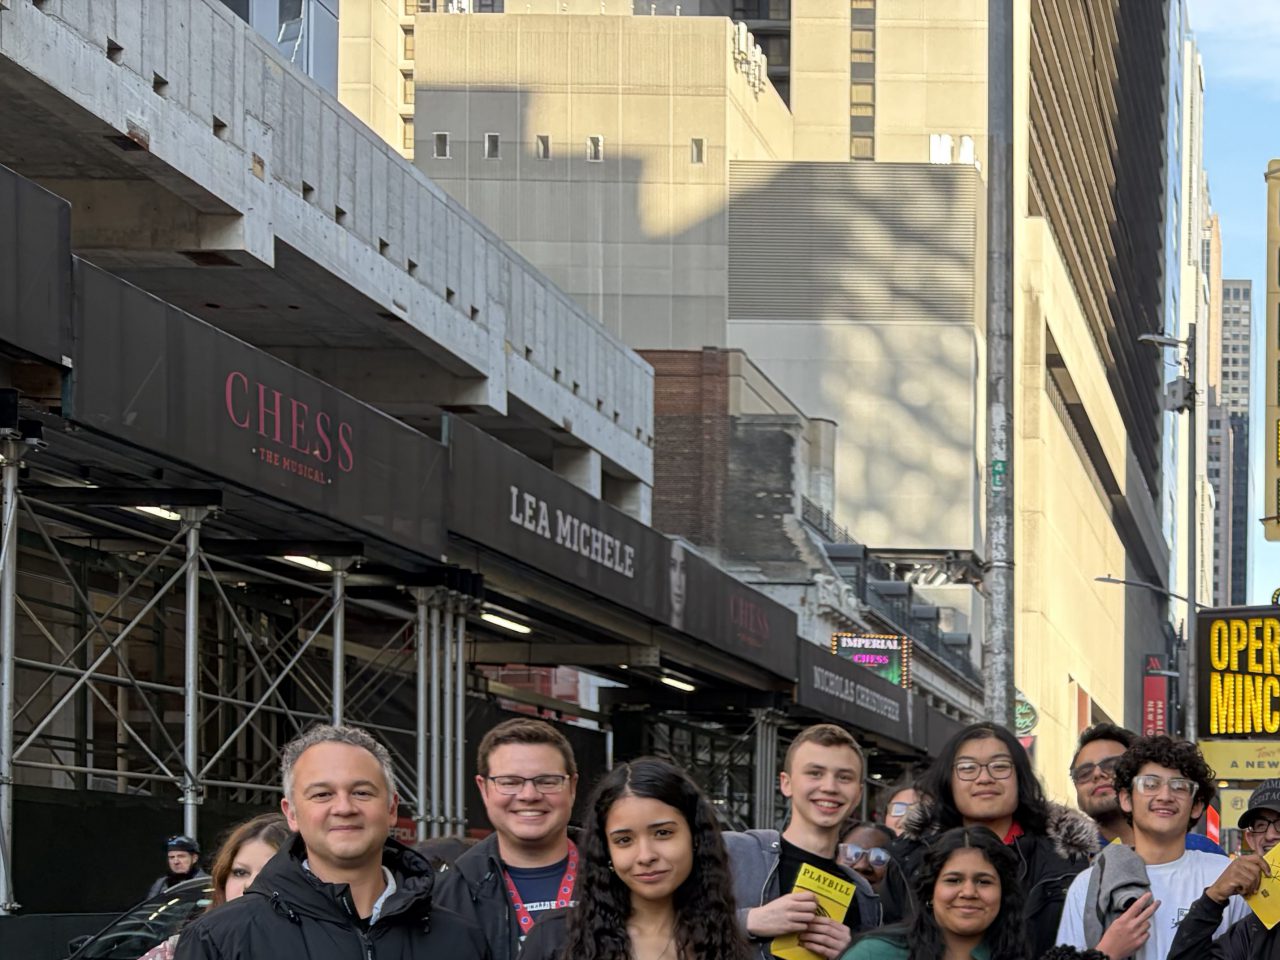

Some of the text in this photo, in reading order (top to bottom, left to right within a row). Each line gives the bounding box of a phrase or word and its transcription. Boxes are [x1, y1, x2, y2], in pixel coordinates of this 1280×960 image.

[225, 370, 353, 472] CHESS
[259, 447, 326, 484] THE MUSICAL
[510, 485, 635, 578] LEA MICHELE
[840, 637, 902, 650] IMPERIAL
[852, 653, 889, 664] CHESS
[813, 664, 855, 702] NICHOLAS
[1230, 760, 1239, 769] A
[1245, 760, 1280, 769] NEW
[802, 868, 851, 896] PLAYBILL
